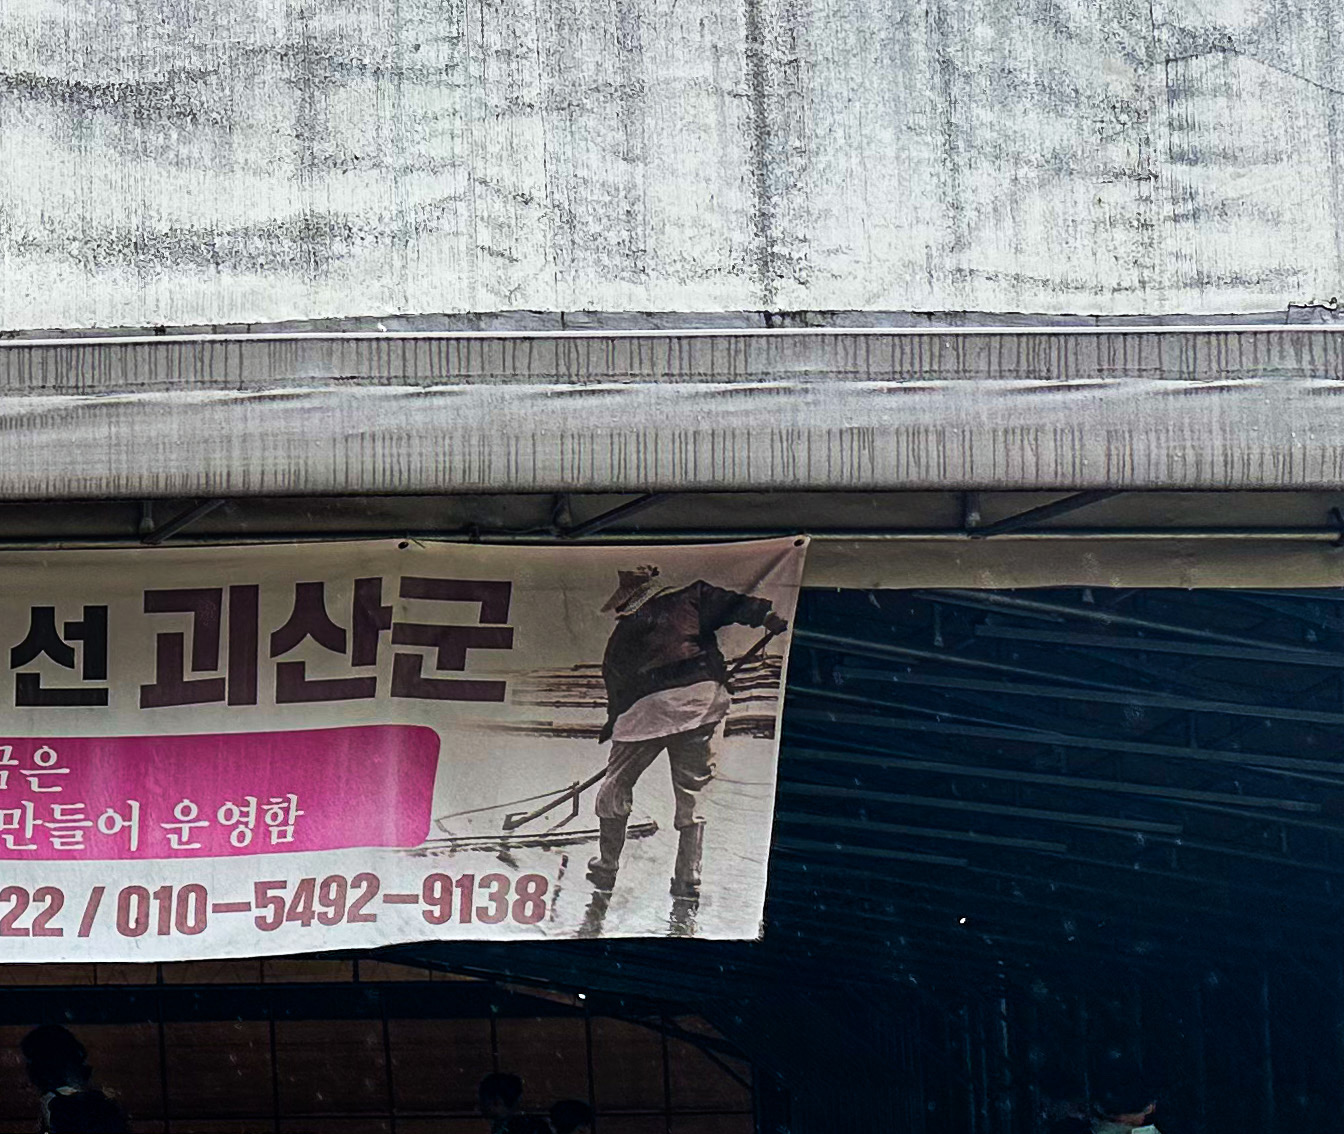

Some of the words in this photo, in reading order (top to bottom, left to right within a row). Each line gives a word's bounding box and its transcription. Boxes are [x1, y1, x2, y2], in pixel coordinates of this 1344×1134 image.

[9, 604, 109, 709] 선
[139, 576, 514, 709] 괴산군
[159, 792, 305, 850] 운영함
[114, 872, 549, 937] 010-5492-9138
